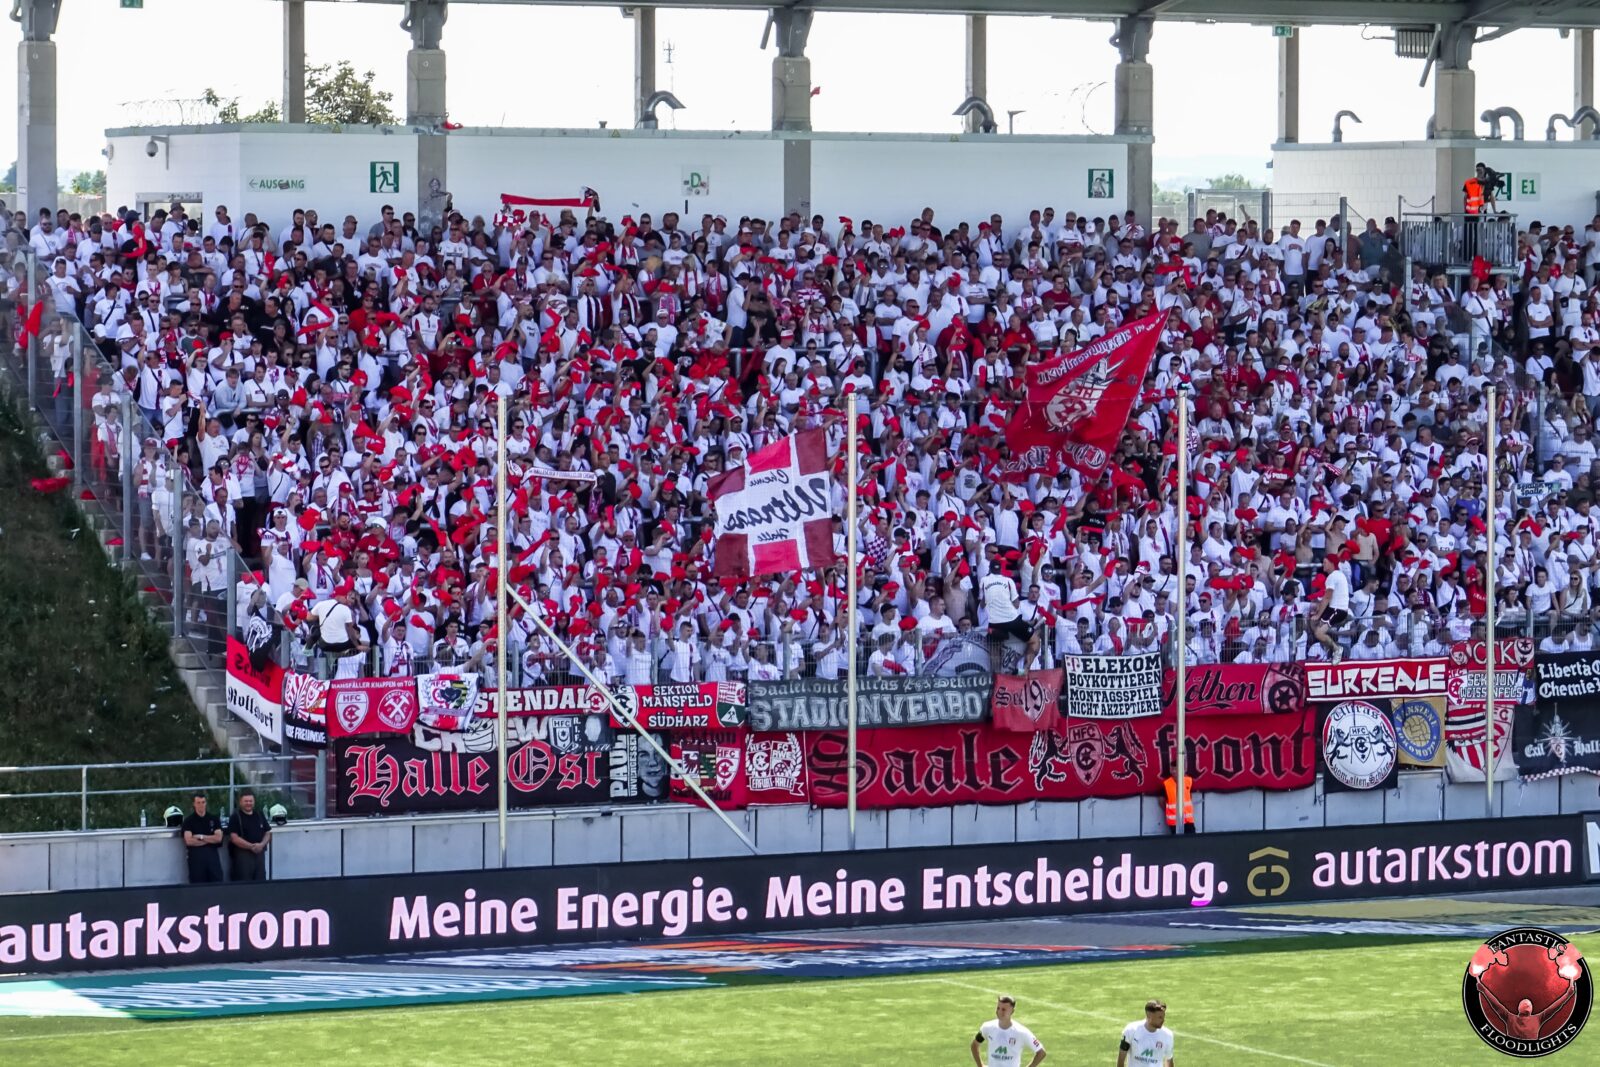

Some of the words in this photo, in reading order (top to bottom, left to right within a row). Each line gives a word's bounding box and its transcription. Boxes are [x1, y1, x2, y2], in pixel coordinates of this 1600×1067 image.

[1521, 179, 1537, 194] E1
[1066, 655, 1161, 674] TELEKOM
[1537, 658, 1591, 679] Libertà
[1069, 670, 1162, 688] BOYKOTTIEREN
[1307, 664, 1446, 696] SURREALE
[1467, 673, 1516, 687] SEKION
[653, 684, 700, 696] SEKTION
[1460, 687, 1523, 699] WEISSNFELS
[1539, 680, 1595, 698] Chemie
[342, 694, 362, 702] HFC
[642, 695, 713, 708] MANSFELD
[1070, 701, 1099, 716] NICHT
[1331, 702, 1381, 722] Ultras
[554, 720, 570, 728] HFC
[648, 712, 709, 728] SÜDHARZ
[1073, 727, 1096, 741] HFC
[717, 750, 736, 759] HFC
[1524, 743, 1546, 758] Exil
[507, 740, 603, 794] Ost
[808, 729, 1024, 798] Saale
[1154, 721, 1313, 783] front
[344, 743, 491, 808] Halle
[0, 901, 330, 966] autarkstrom
[388, 887, 539, 941] Meine
[556, 874, 749, 938] Energie.
[765, 868, 906, 920] Meine
[922, 853, 1230, 908] Entscheidung.
[1313, 837, 1574, 888] autarkstrom
